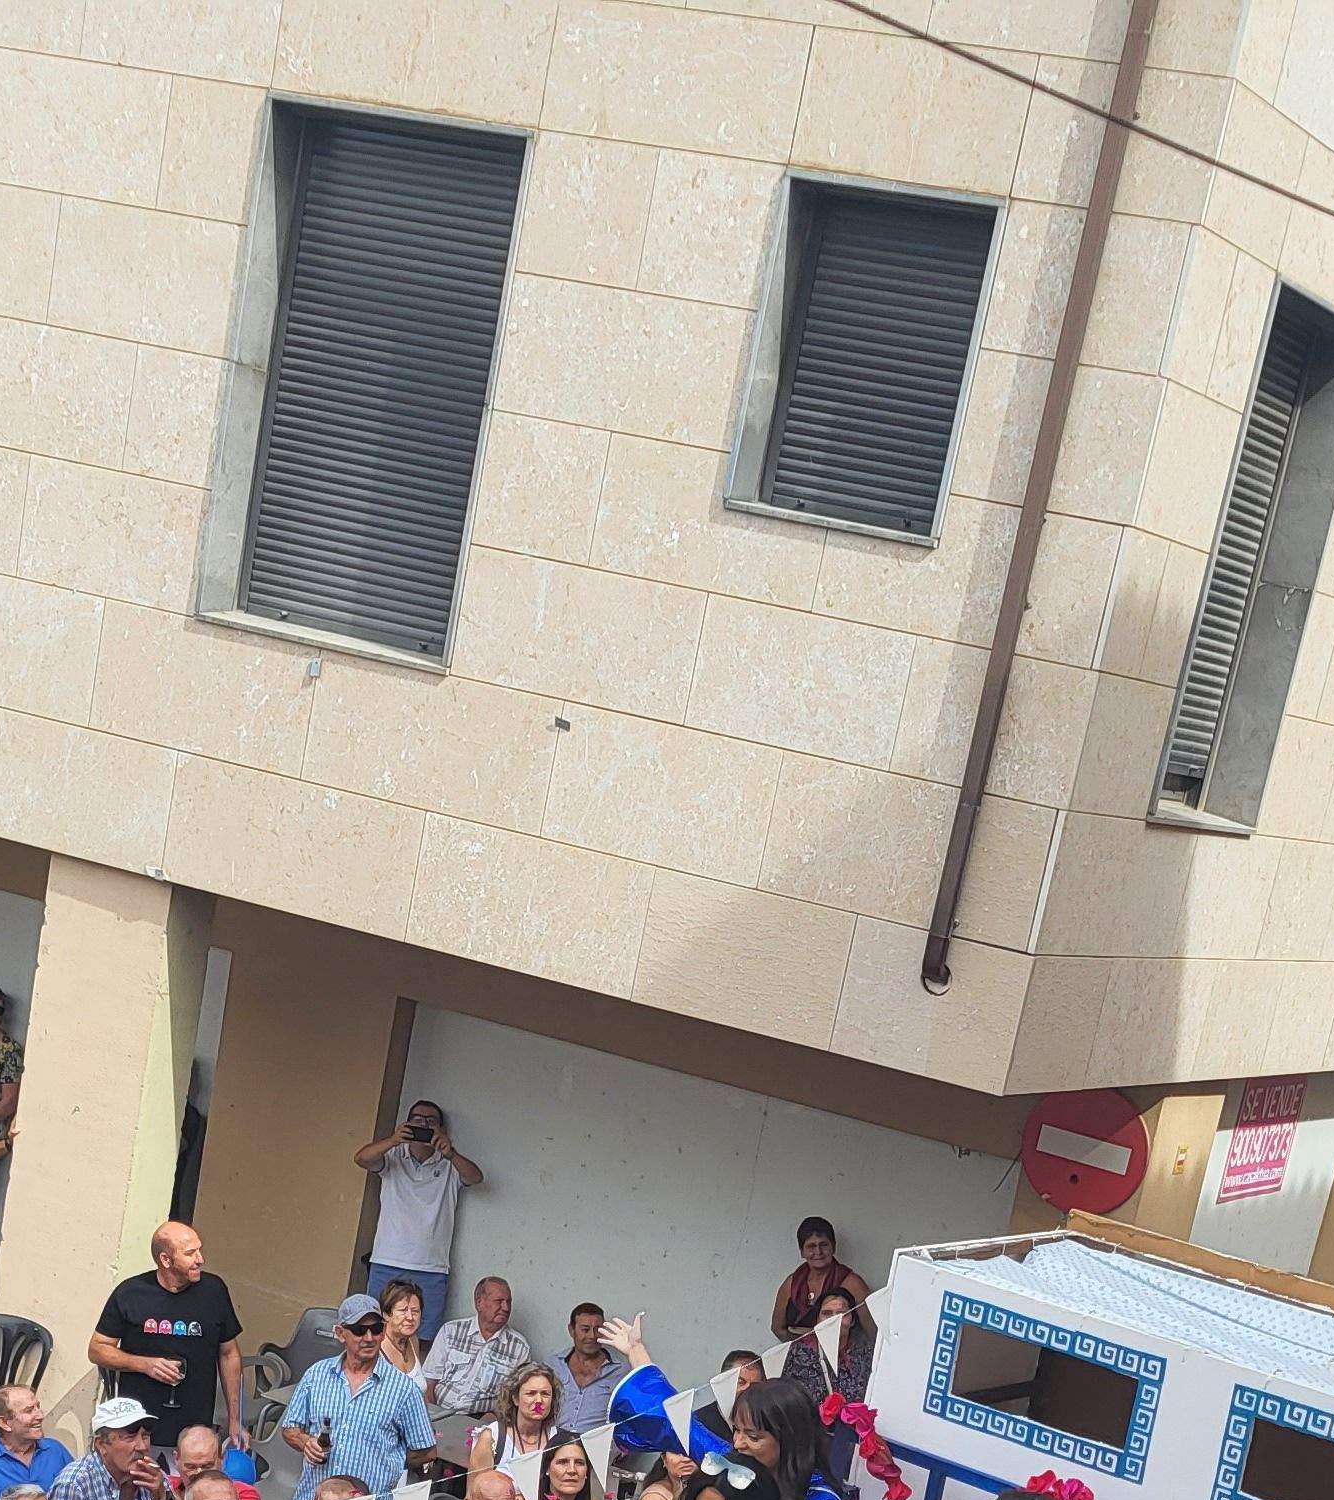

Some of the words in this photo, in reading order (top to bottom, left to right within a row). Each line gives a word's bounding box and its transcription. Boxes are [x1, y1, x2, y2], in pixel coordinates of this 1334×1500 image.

[1242, 1087, 1264, 1121] SE
[1262, 1083, 1304, 1120] VENDE
[1230, 1123, 1294, 1168] 900907373
